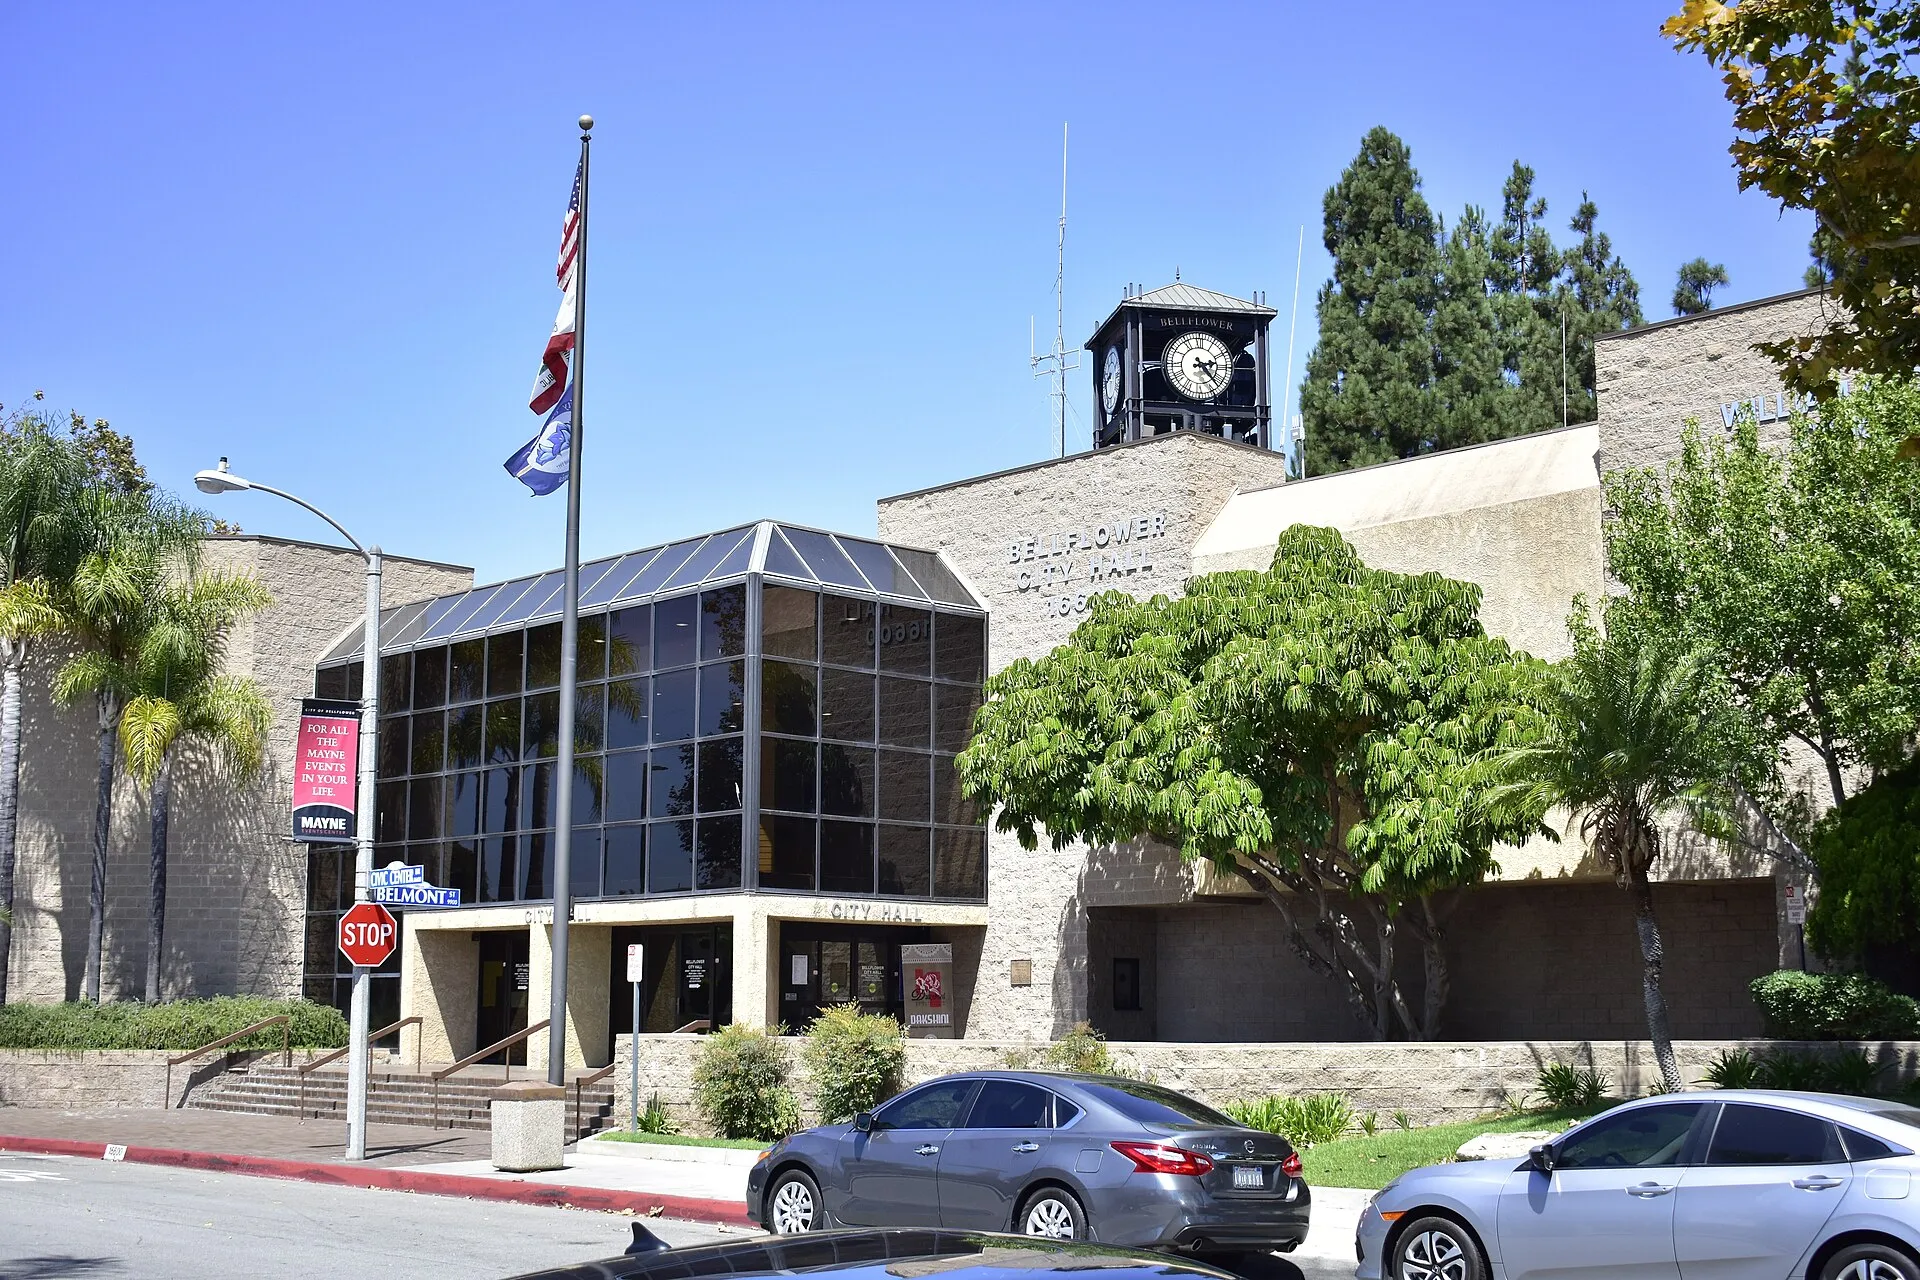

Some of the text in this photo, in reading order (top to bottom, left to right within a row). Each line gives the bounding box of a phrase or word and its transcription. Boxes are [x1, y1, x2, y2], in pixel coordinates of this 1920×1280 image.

[1160, 317, 1233, 330] BELLFLOWER
[1008, 512, 1166, 565] BELLFLOWER
[1016, 549, 1153, 593] CITY HALL
[307, 725, 349, 735] FOR ALL
[316, 737, 338, 747] THE
[307, 750, 345, 759] MAYNE
[305, 762, 346, 772] EVENTS
[301, 774, 348, 785] IN YOUR
[312, 787, 336, 797] LIFE.
[301, 816, 346, 830] MAYNE
[371, 871, 388, 887] CIVIC
[390, 869, 414, 885] CENTER
[377, 887, 447, 905] BELMONT
[525, 906, 553, 924] CITY
[831, 902, 922, 923] CITY HALL
[343, 922, 393, 947] STOP
[910, 1013, 949, 1025] DAKSHINI
